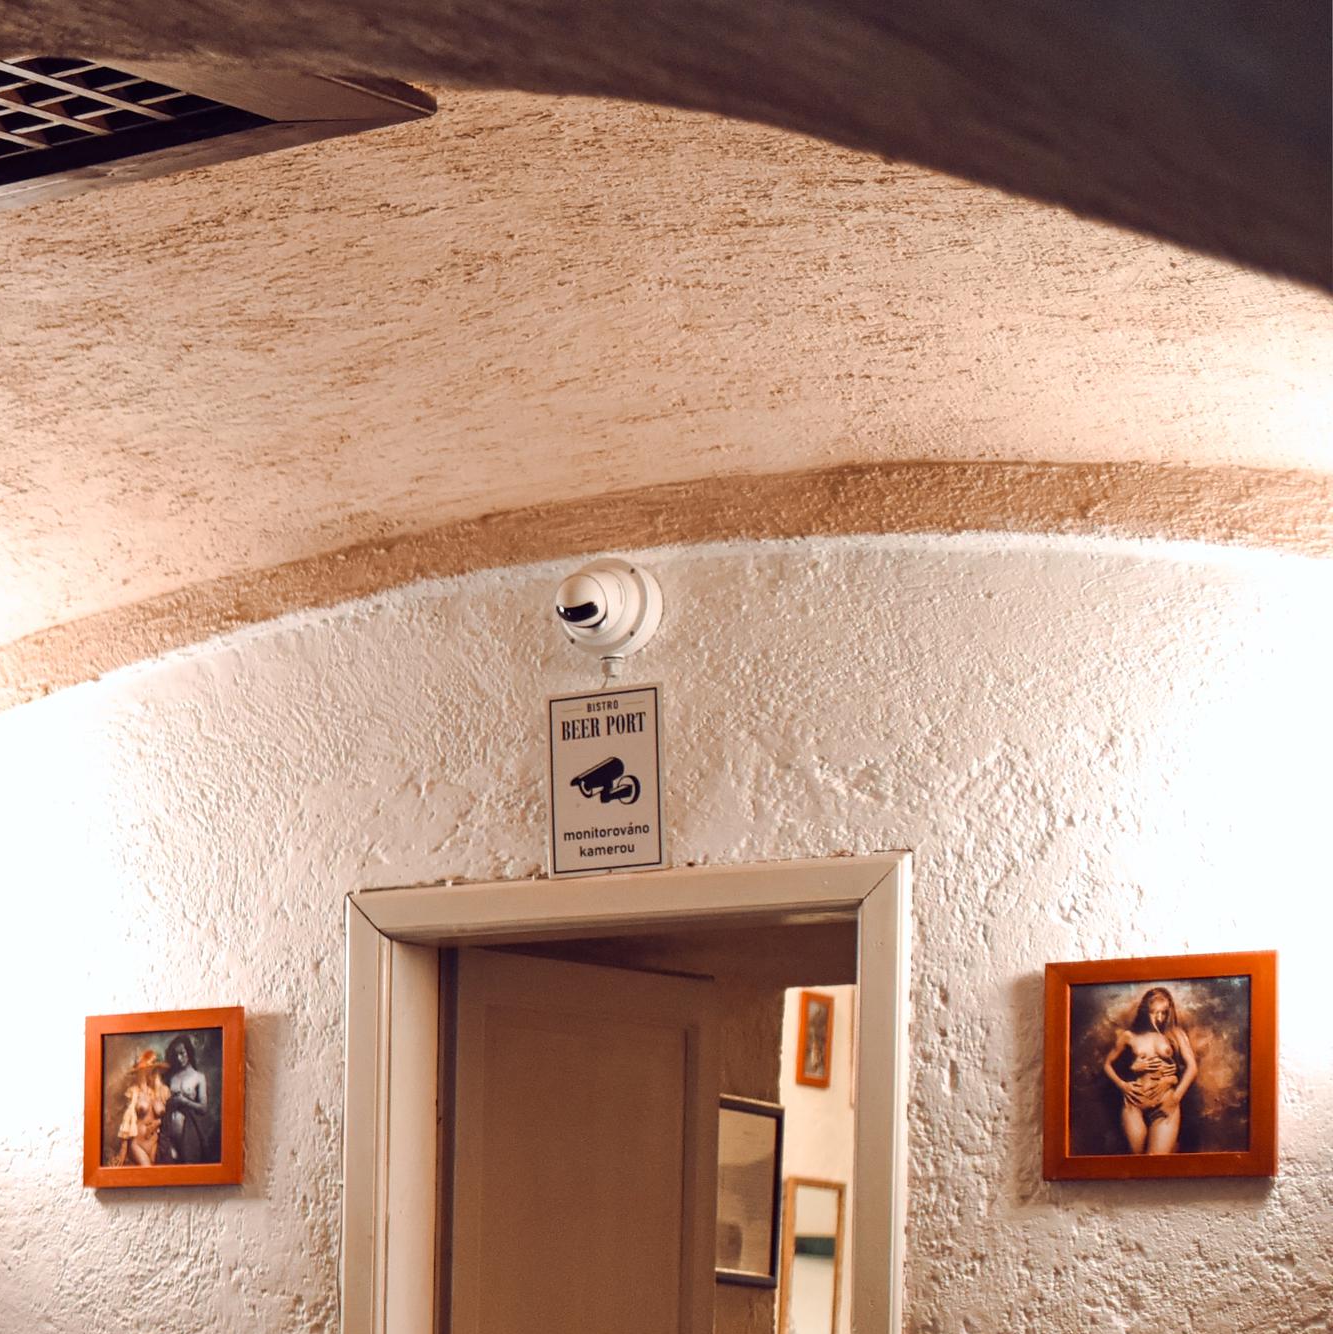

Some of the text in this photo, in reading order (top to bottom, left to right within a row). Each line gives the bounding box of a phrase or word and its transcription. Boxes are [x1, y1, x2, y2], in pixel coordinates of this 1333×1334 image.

[586, 700, 619, 713] BISTRO
[561, 711, 646, 742] BEER PORT
[563, 822, 650, 842] monitorováno
[579, 843, 636, 858] kamerou
